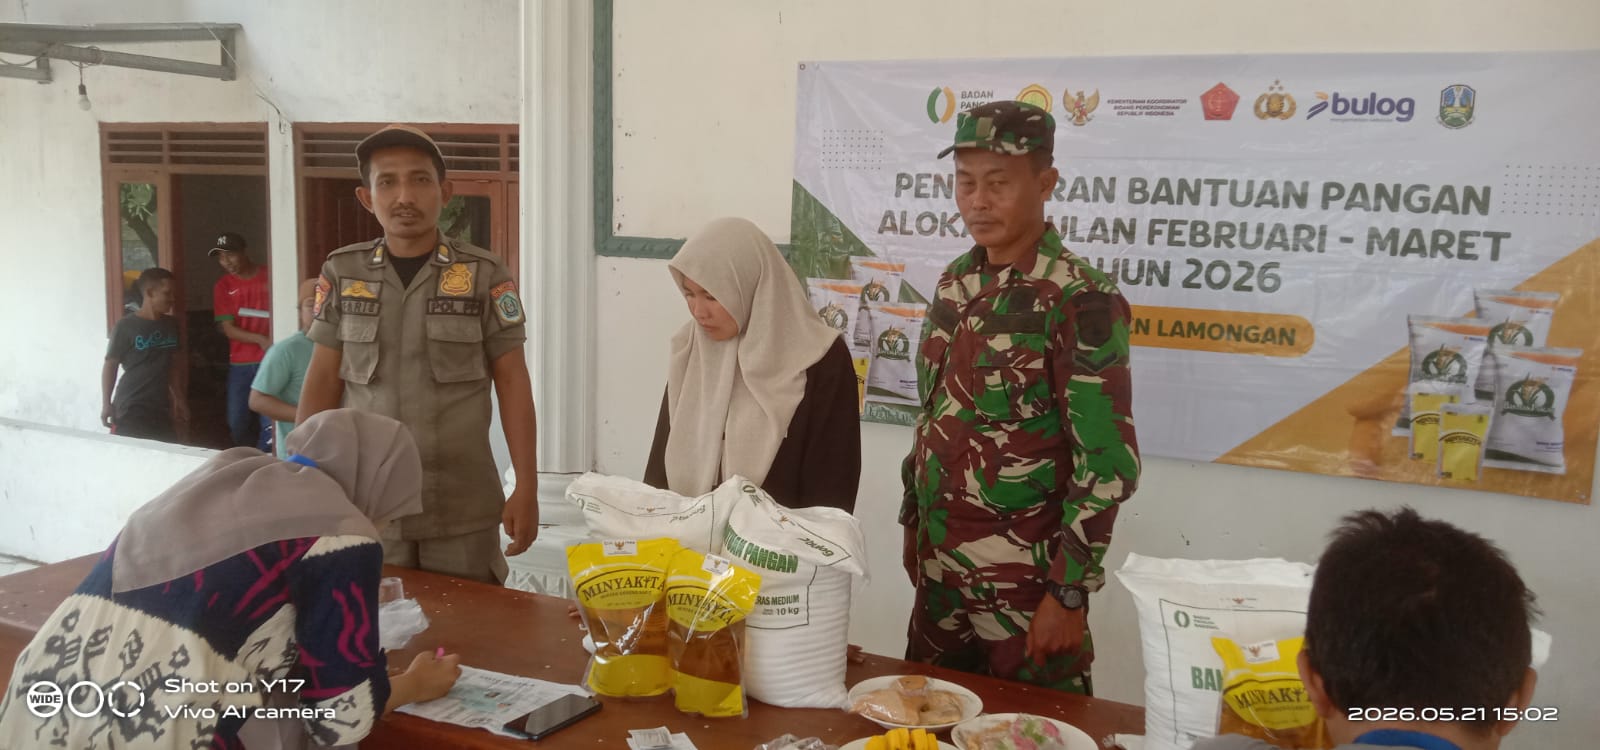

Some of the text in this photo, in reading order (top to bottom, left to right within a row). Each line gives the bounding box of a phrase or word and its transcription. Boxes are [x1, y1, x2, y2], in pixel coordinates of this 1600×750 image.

[961, 90, 994, 99] BADAN
[1331, 92, 1416, 122] bulog
[894, 172, 1491, 216] PENRAN BANTUAN PANGAN
[1046, 216, 1137, 245] ULAN
[1147, 217, 1328, 253] FEBRUARI
[1339, 236, 1354, 244] -
[1364, 226, 1512, 262] MARET
[1086, 257, 1282, 294] HUN 2026
[431, 301, 457, 313] POL
[1157, 319, 1296, 346] LAMONGAN
[743, 542, 799, 574] PANGAN
[582, 575, 665, 602] MINYAKITA
[771, 594, 800, 606] MEDIUM
[776, 607, 786, 615] 10
[788, 607, 800, 615] kg
